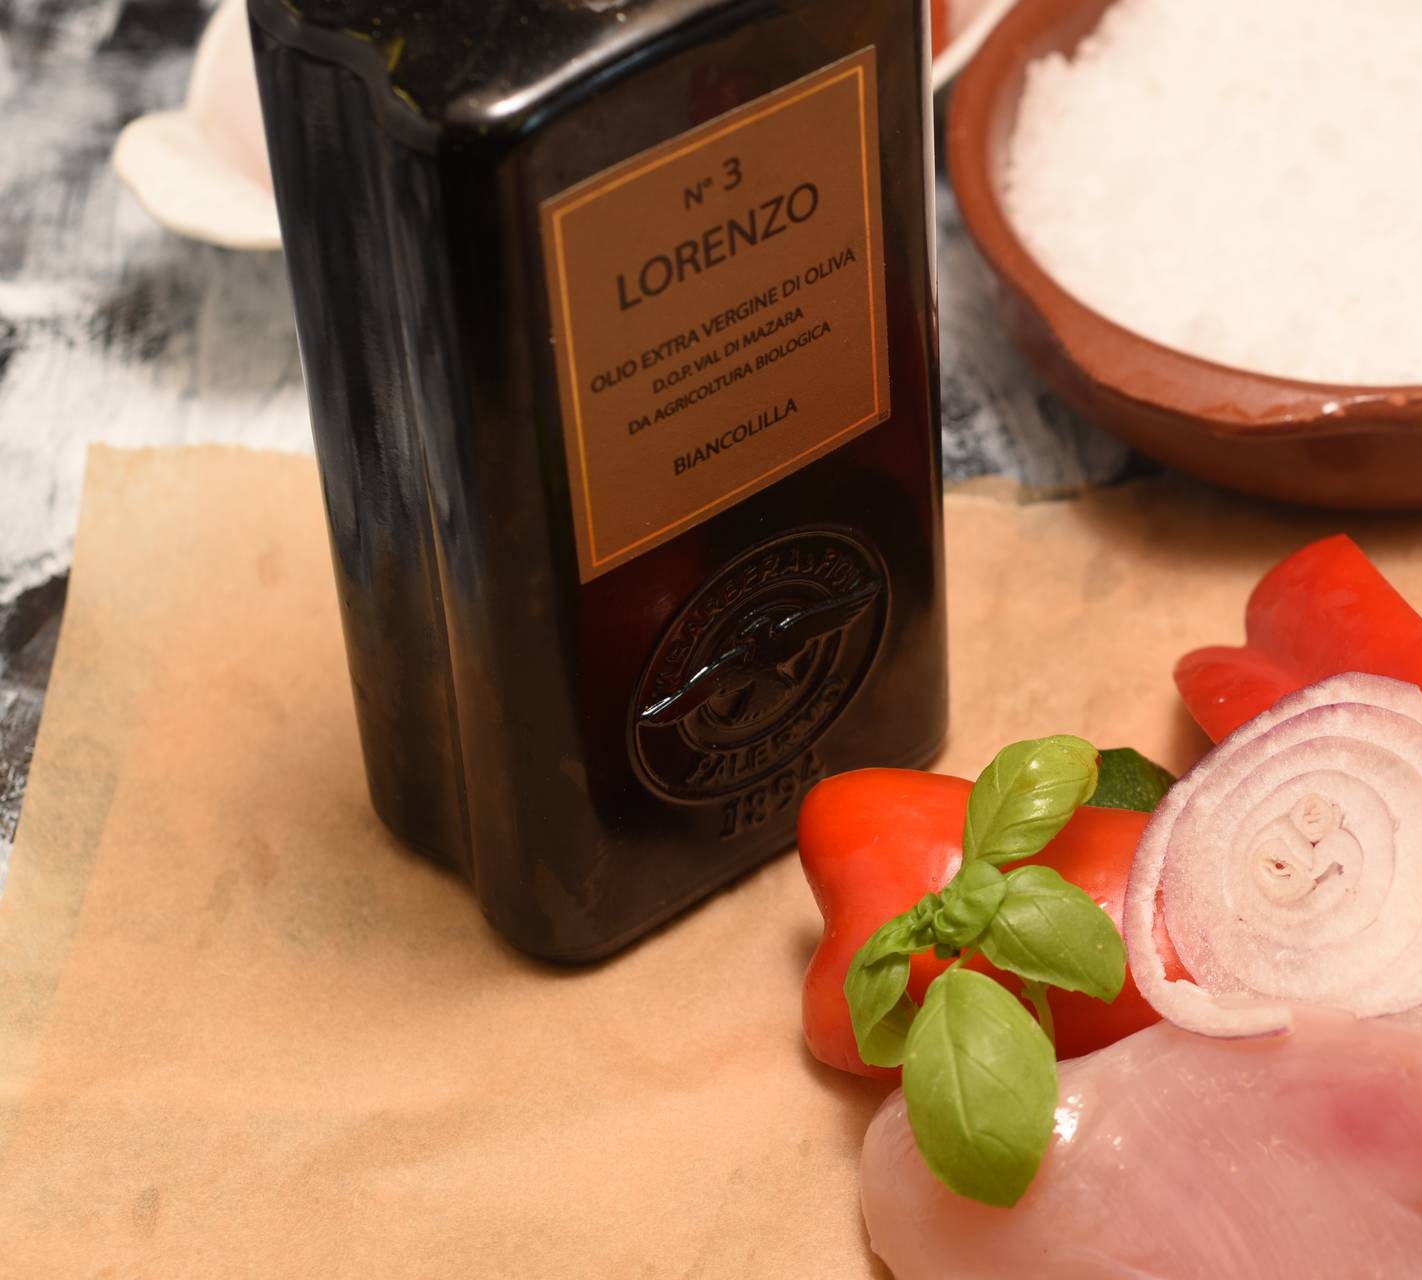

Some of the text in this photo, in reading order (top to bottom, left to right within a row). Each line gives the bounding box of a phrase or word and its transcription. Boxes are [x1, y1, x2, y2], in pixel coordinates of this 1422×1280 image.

[722, 156, 743, 192] 3
[616, 182, 819, 312] LORENZO
[590, 247, 856, 394] OLIO EXTRA VERGINE DI OLIVA
[693, 350, 722, 374] VAL
[723, 339, 740, 357] DI
[742, 306, 804, 346] MAZARA
[628, 320, 832, 436] DA AGRICOLTURA BIOLOGICA
[673, 397, 799, 477] BIANCOLILLA
[684, 675, 852, 785] PALERMO
